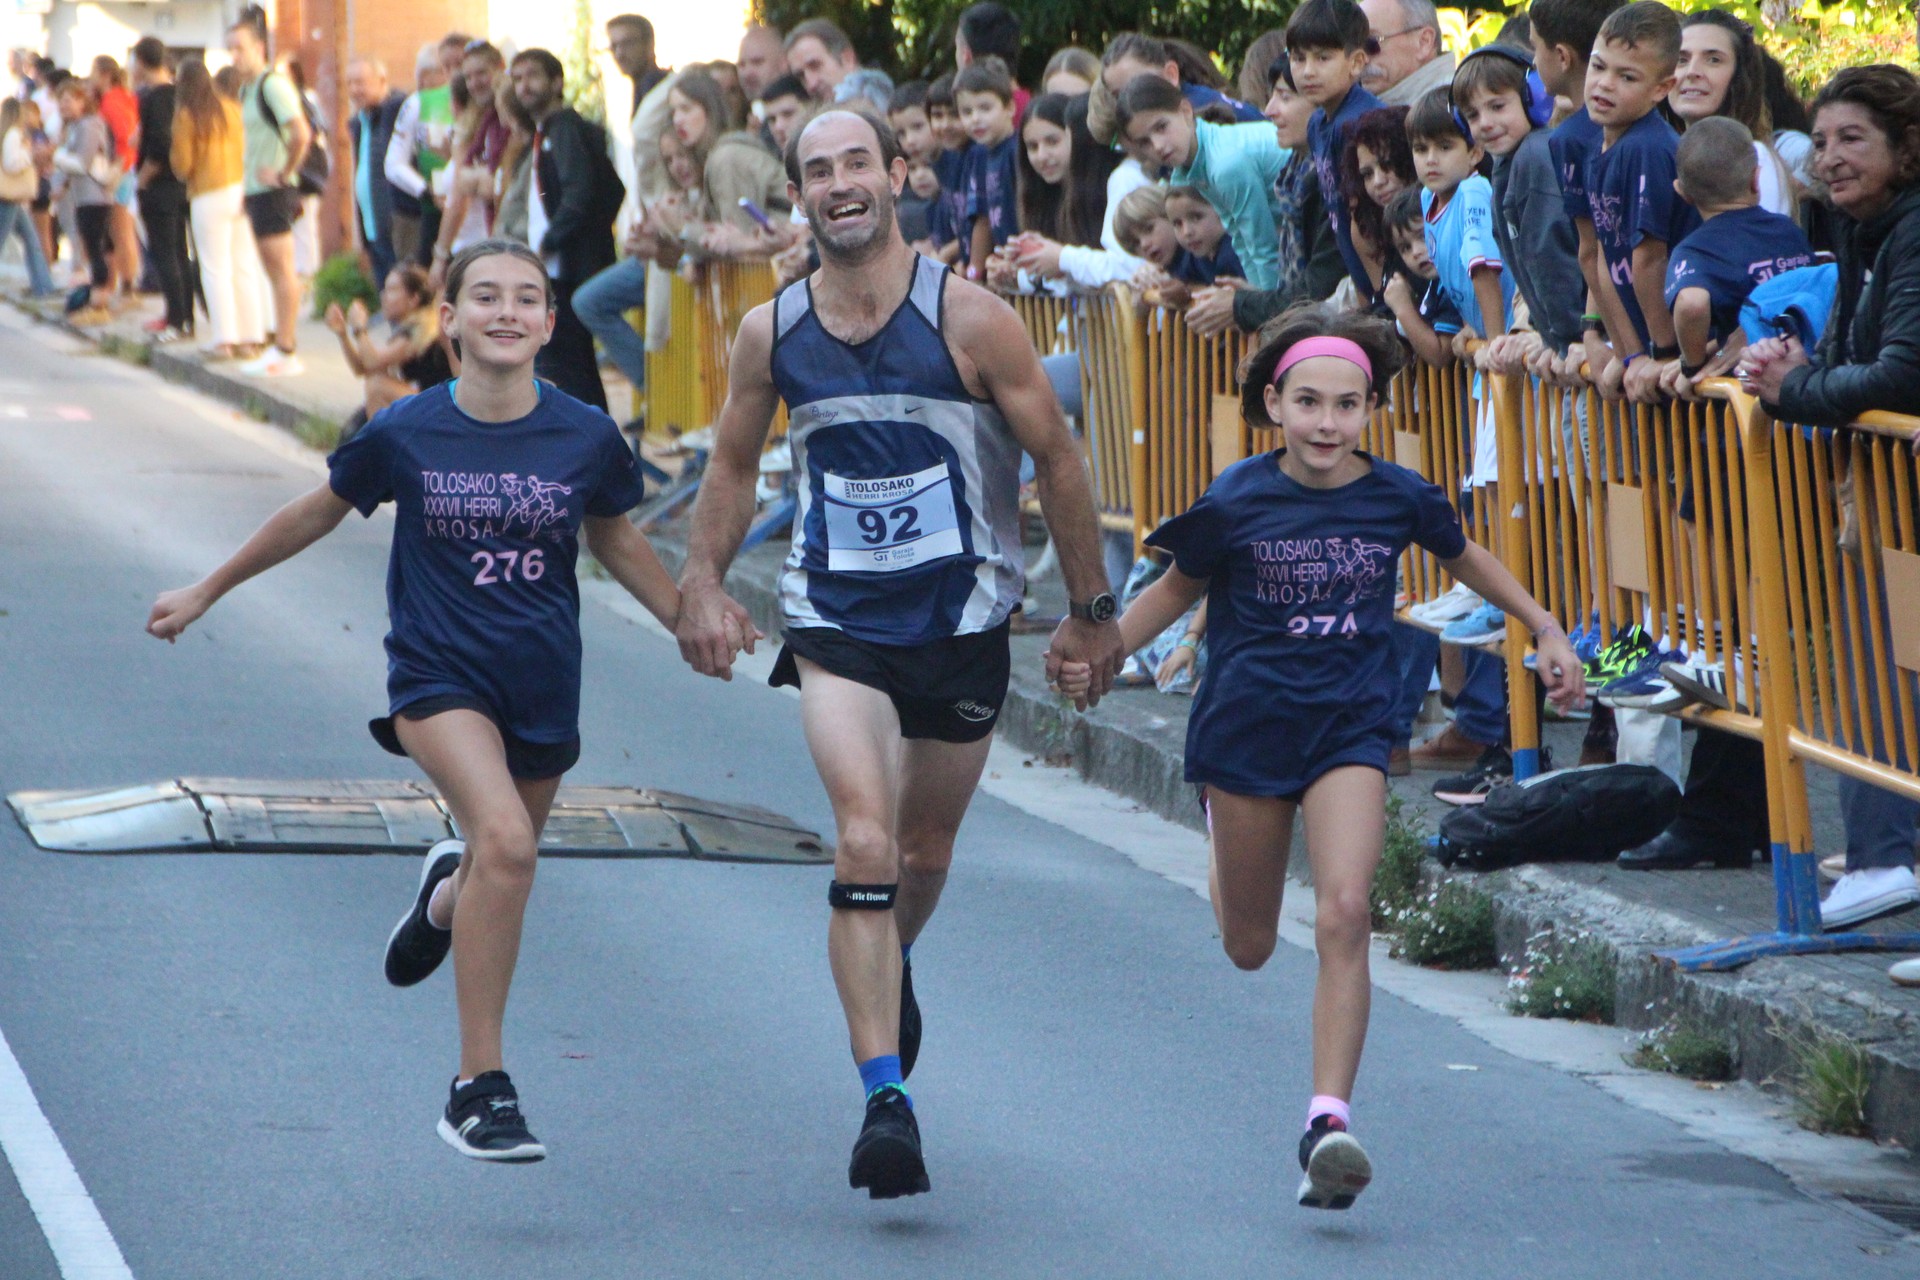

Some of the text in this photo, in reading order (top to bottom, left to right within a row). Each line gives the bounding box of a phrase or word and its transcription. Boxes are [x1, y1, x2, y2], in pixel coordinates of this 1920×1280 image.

[421, 471, 496, 495] TOLOSAKO
[850, 477, 915, 493] TOLOSAKO
[882, 488, 914, 499] KROSA
[463, 497, 501, 518] HERRI
[856, 505, 922, 545] 92
[1251, 538, 1322, 562] TOLOSAKO
[470, 549, 545, 586] 276
[1292, 562, 1328, 581] HERRI
